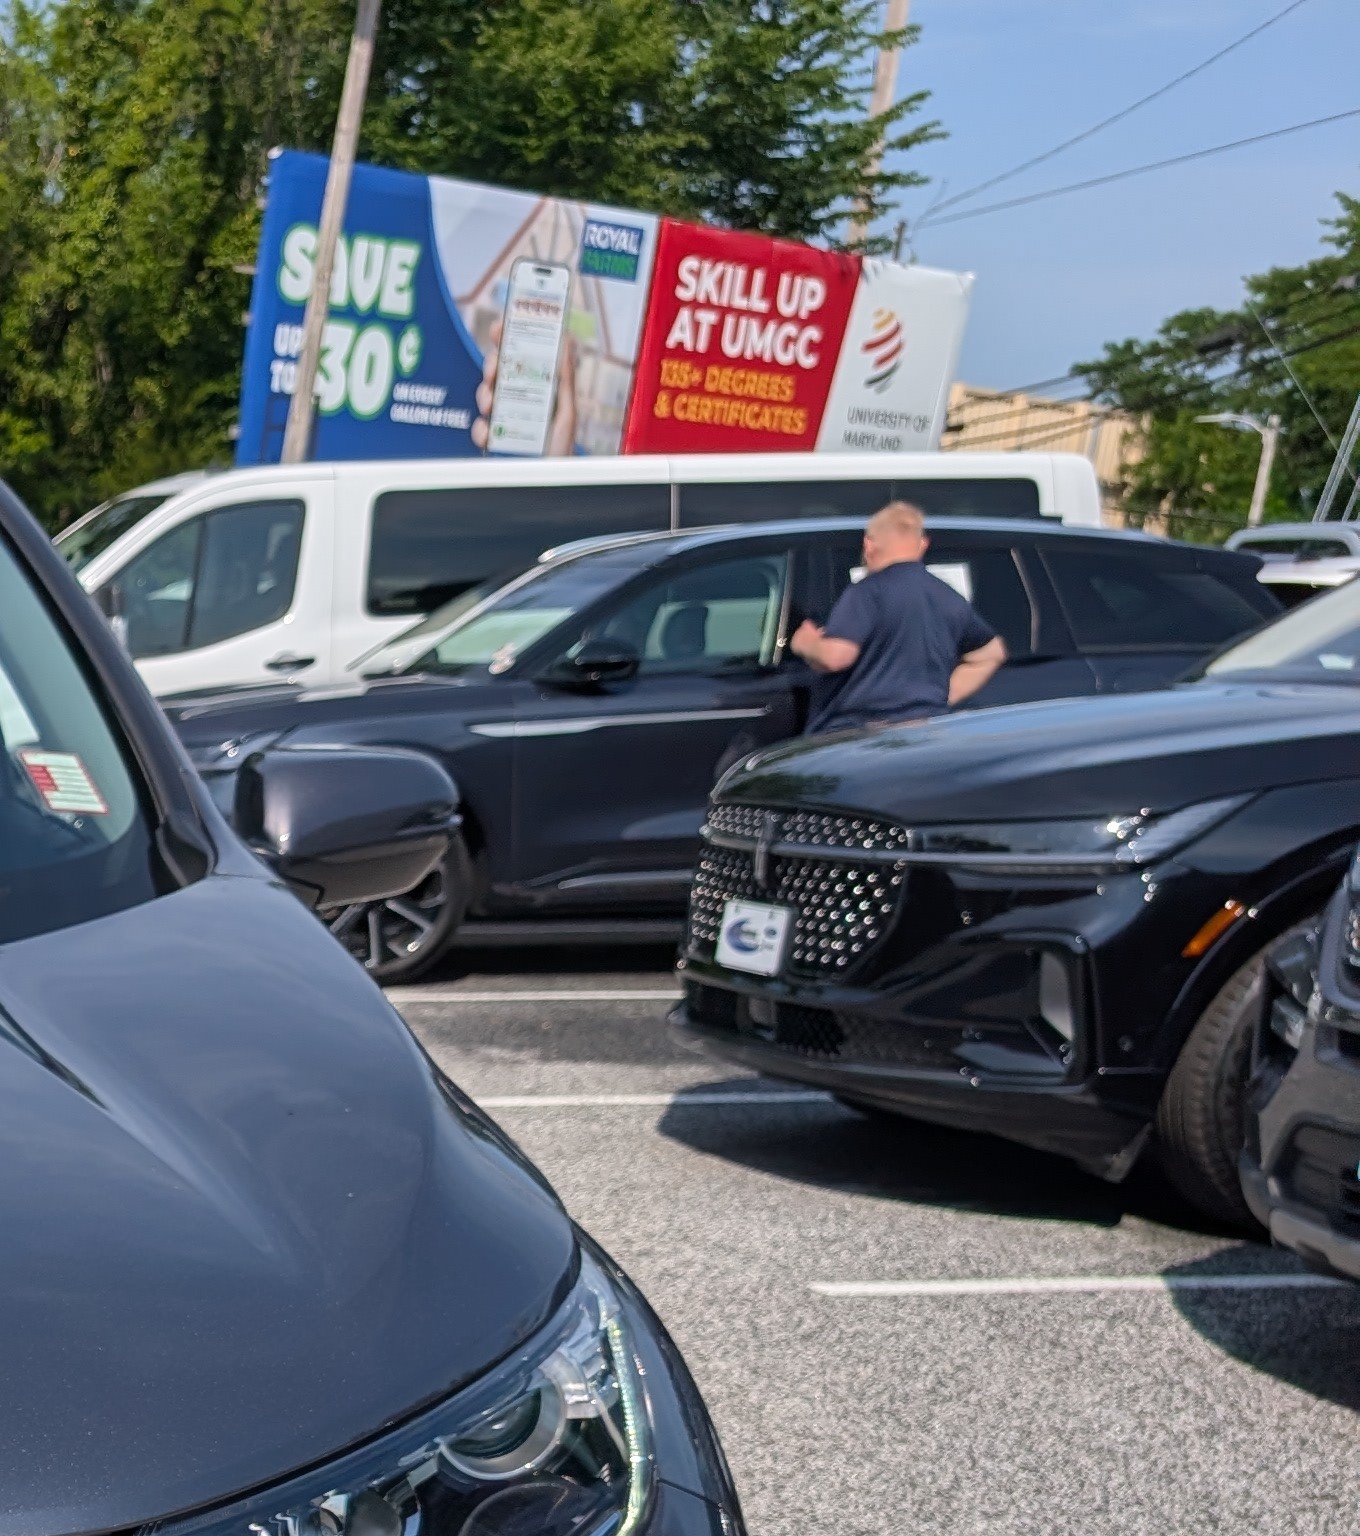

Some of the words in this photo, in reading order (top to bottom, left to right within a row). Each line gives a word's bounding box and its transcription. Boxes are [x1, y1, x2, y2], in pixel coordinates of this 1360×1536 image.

[584, 223, 639, 255] ROYAL
[675, 254, 770, 314] SKILL
[777, 270, 827, 320] UP
[665, 304, 720, 354] AT
[721, 312, 823, 369] UMGC
[704, 365, 796, 404] DEGREES
[654, 389, 672, 419] &
[673, 391, 808, 436] CERTIFICATES
[846, 407, 911, 430] UNIVERSITY
[912, 415, 930, 433] OF
[841, 429, 903, 451] MARYLAND
